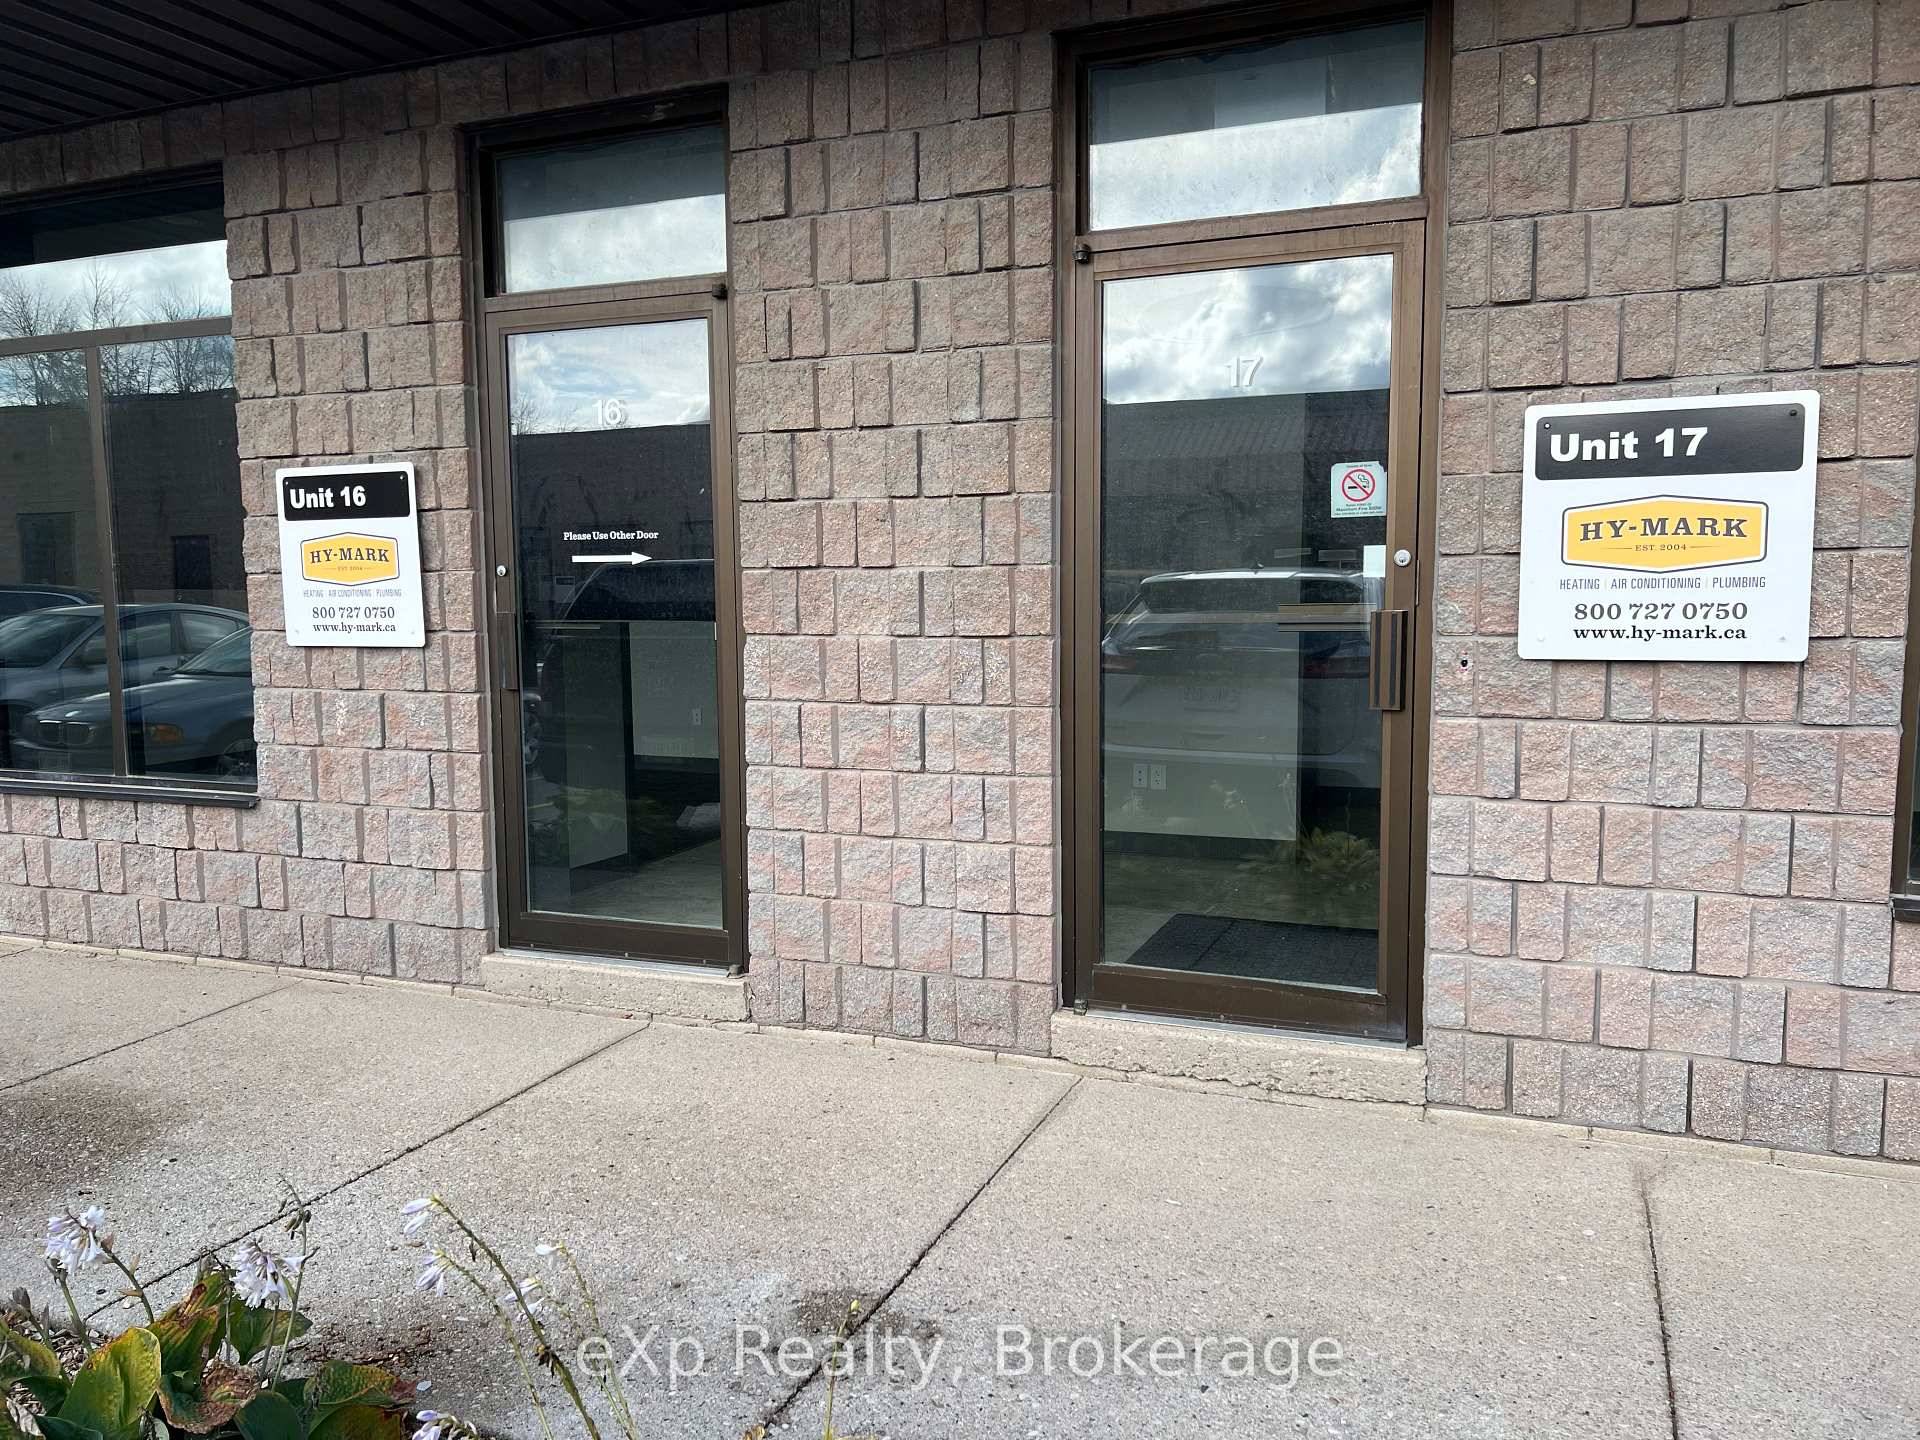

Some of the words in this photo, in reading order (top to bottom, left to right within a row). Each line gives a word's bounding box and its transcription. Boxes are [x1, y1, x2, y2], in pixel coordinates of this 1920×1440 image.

[1224, 355, 1264, 388] 17
[592, 399, 621, 425] 16
[1550, 430, 1639, 463] Unit
[1655, 427, 1708, 457] 17
[289, 488, 335, 509] Unit
[340, 486, 367, 507] 16
[563, 531, 591, 541] Please
[592, 531, 609, 540] Use
[609, 530, 636, 540] Other
[636, 530, 660, 540] Door
[1579, 517, 1748, 542] HY-MARK
[309, 547, 390, 564] HY-MARK
[1559, 578, 1600, 590] HEATING
[1611, 578, 1627, 590] AIR
[1630, 577, 1701, 590] CONDITIONING
[1712, 576, 1766, 588] PLUMBING
[312, 606, 336, 619] 800
[338, 606, 361, 619] 727
[364, 606, 395, 619] 0750
[1574, 603, 1622, 620] 800
[1629, 603, 1675, 620] 727
[1682, 602, 1748, 620] 0750
[312, 622, 396, 634] www.hy-mark.ca
[1573, 625, 1748, 642] www.hy-mark.ca
